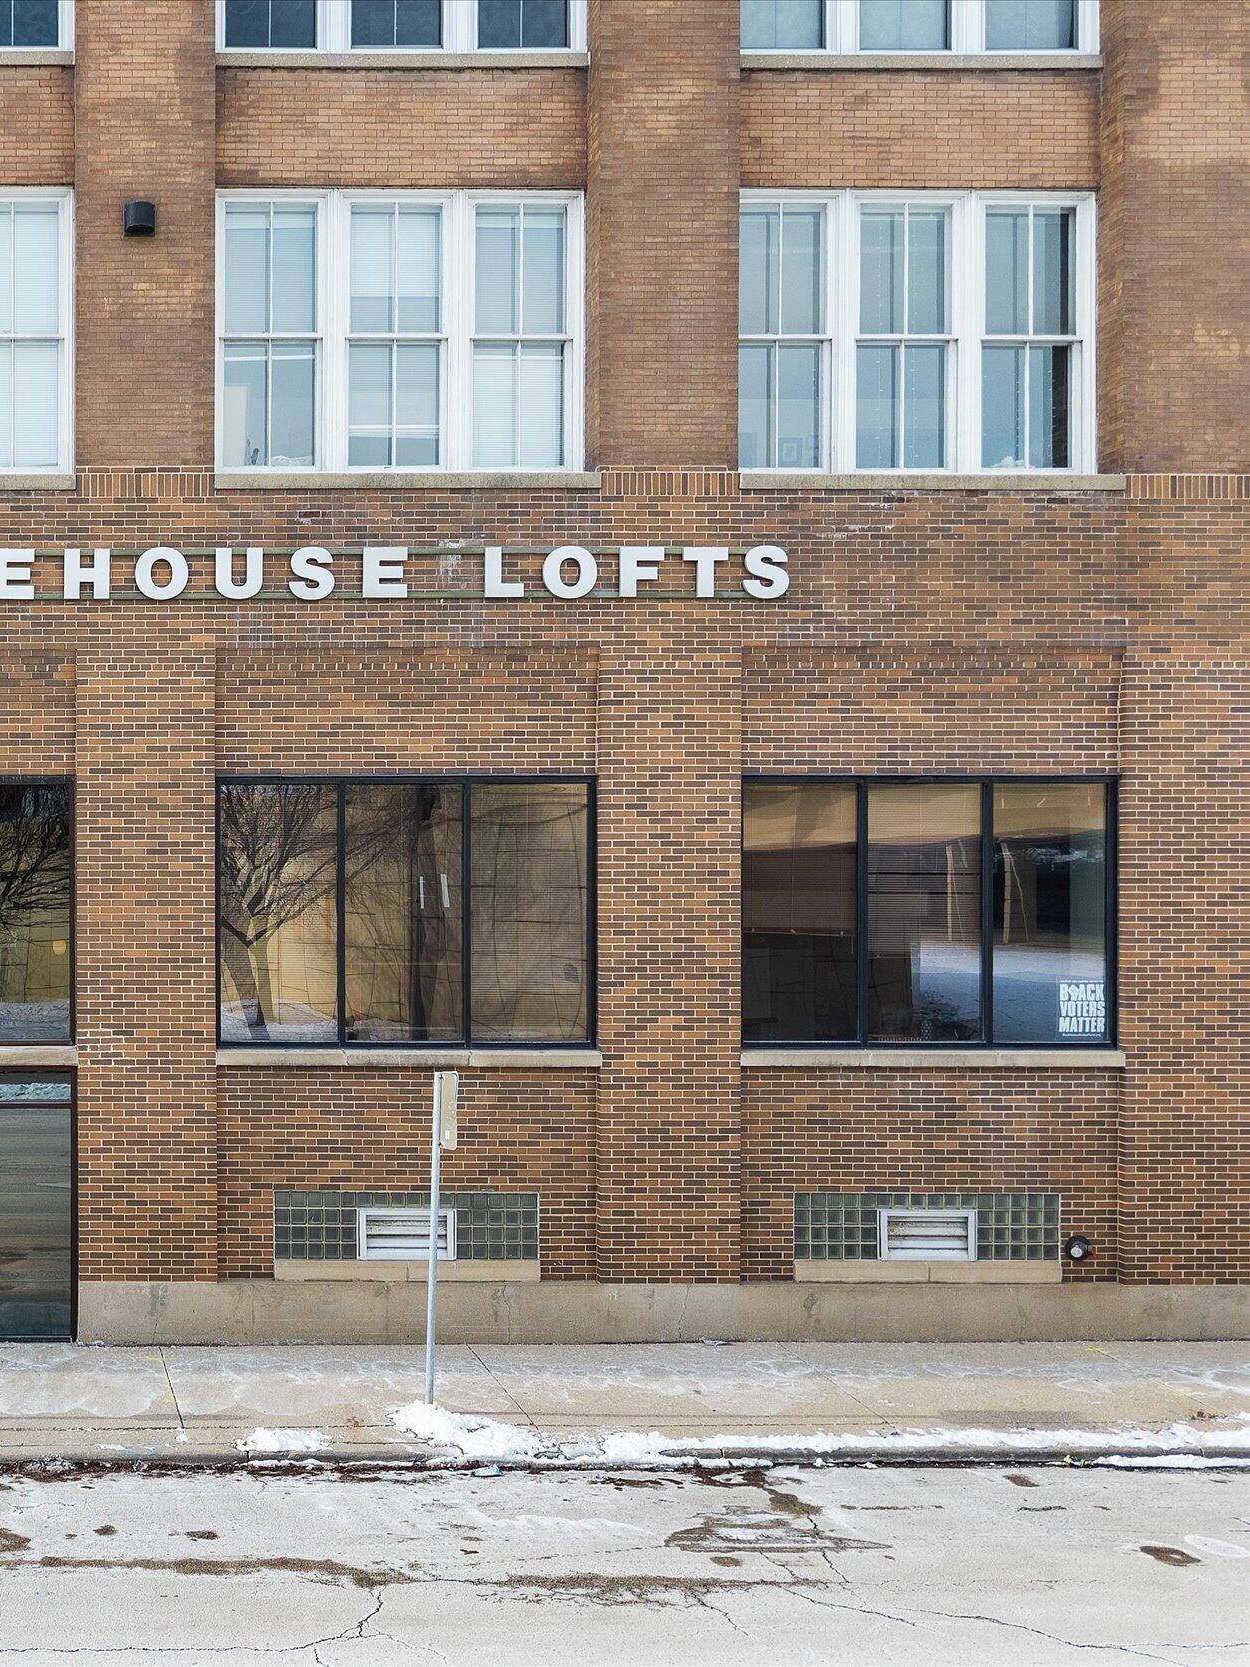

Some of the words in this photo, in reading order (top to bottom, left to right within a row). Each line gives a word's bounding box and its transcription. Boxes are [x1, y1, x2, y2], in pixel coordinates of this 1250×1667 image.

[484, 544, 791, 600] LOFTS
[1059, 1001, 1106, 1017] VOTERS
[1058, 1017, 1106, 1033] MATTER
